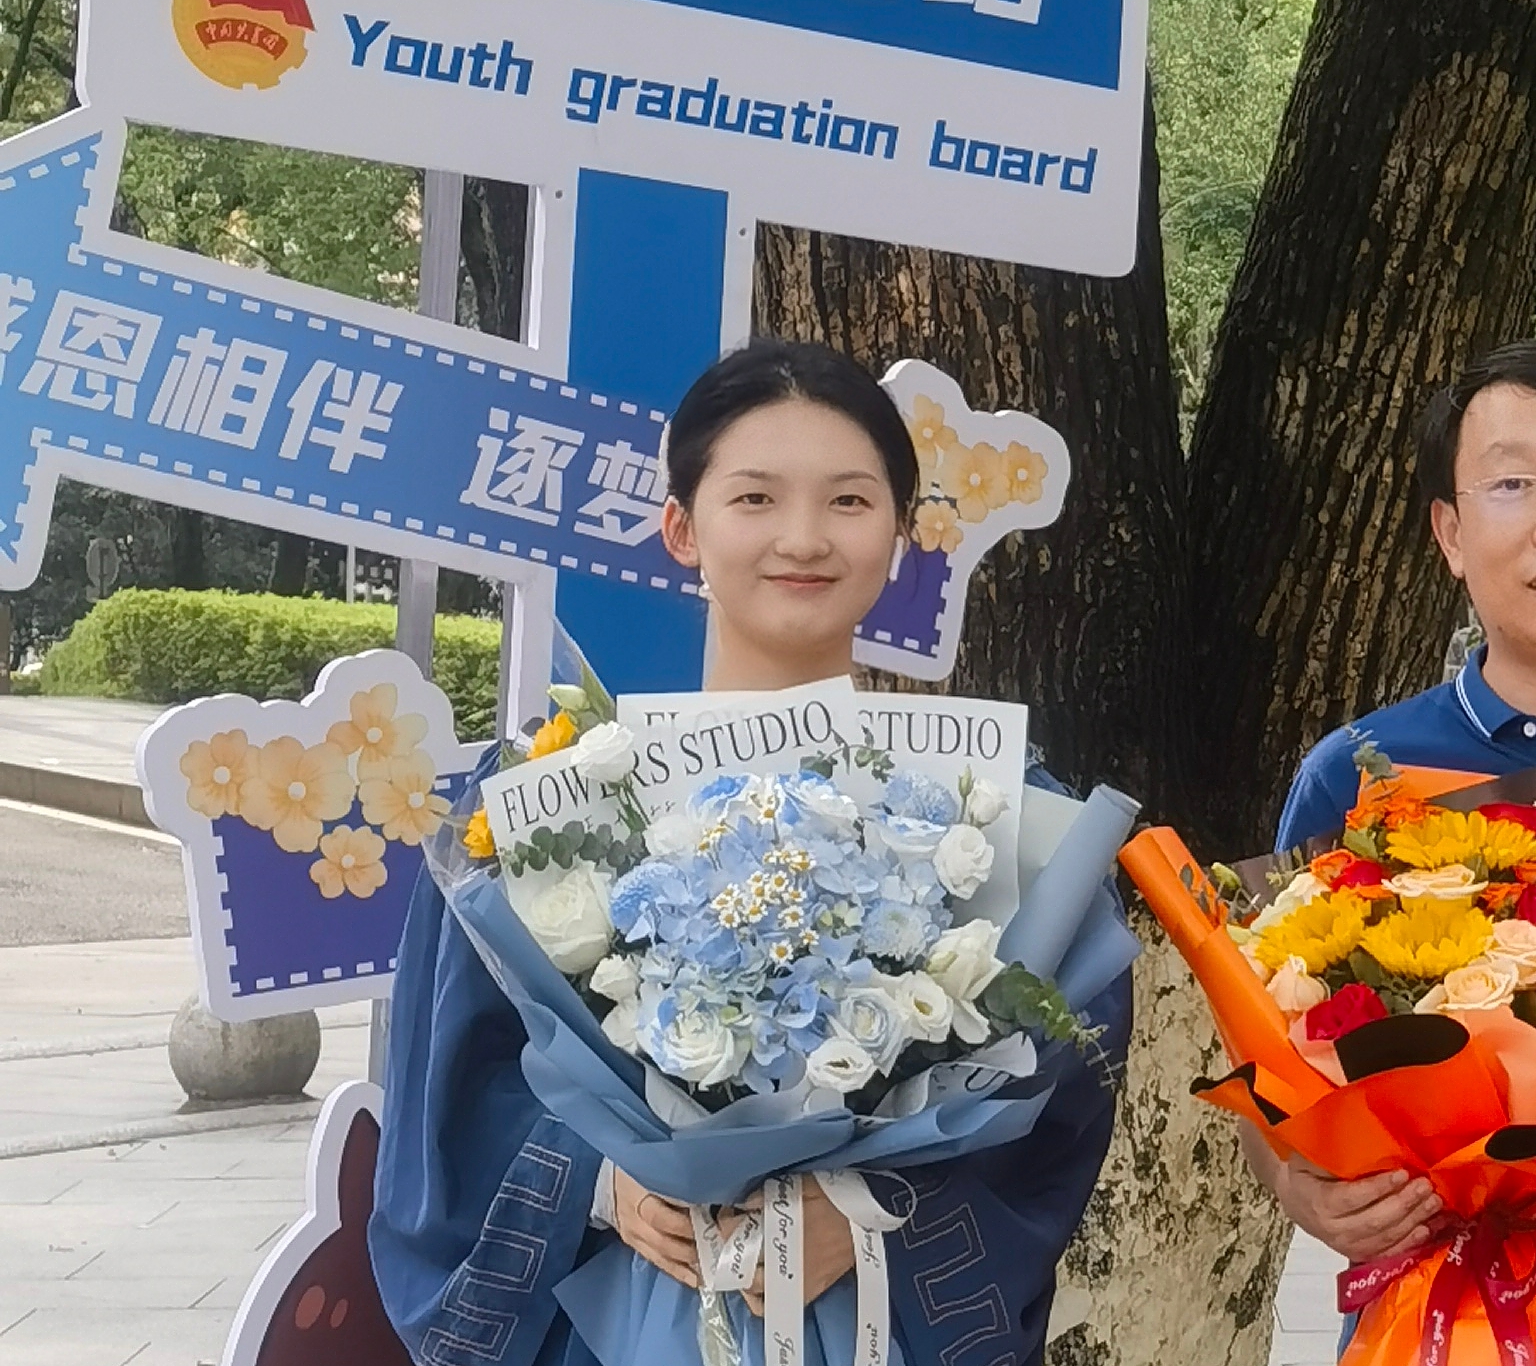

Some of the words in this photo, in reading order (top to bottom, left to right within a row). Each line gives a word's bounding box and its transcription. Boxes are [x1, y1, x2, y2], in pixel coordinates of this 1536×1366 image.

[343, 13, 535, 96] Youth
[565, 68, 899, 160] graduation
[928, 119, 1098, 194] board
[679, 700, 832, 776] STUDIO
